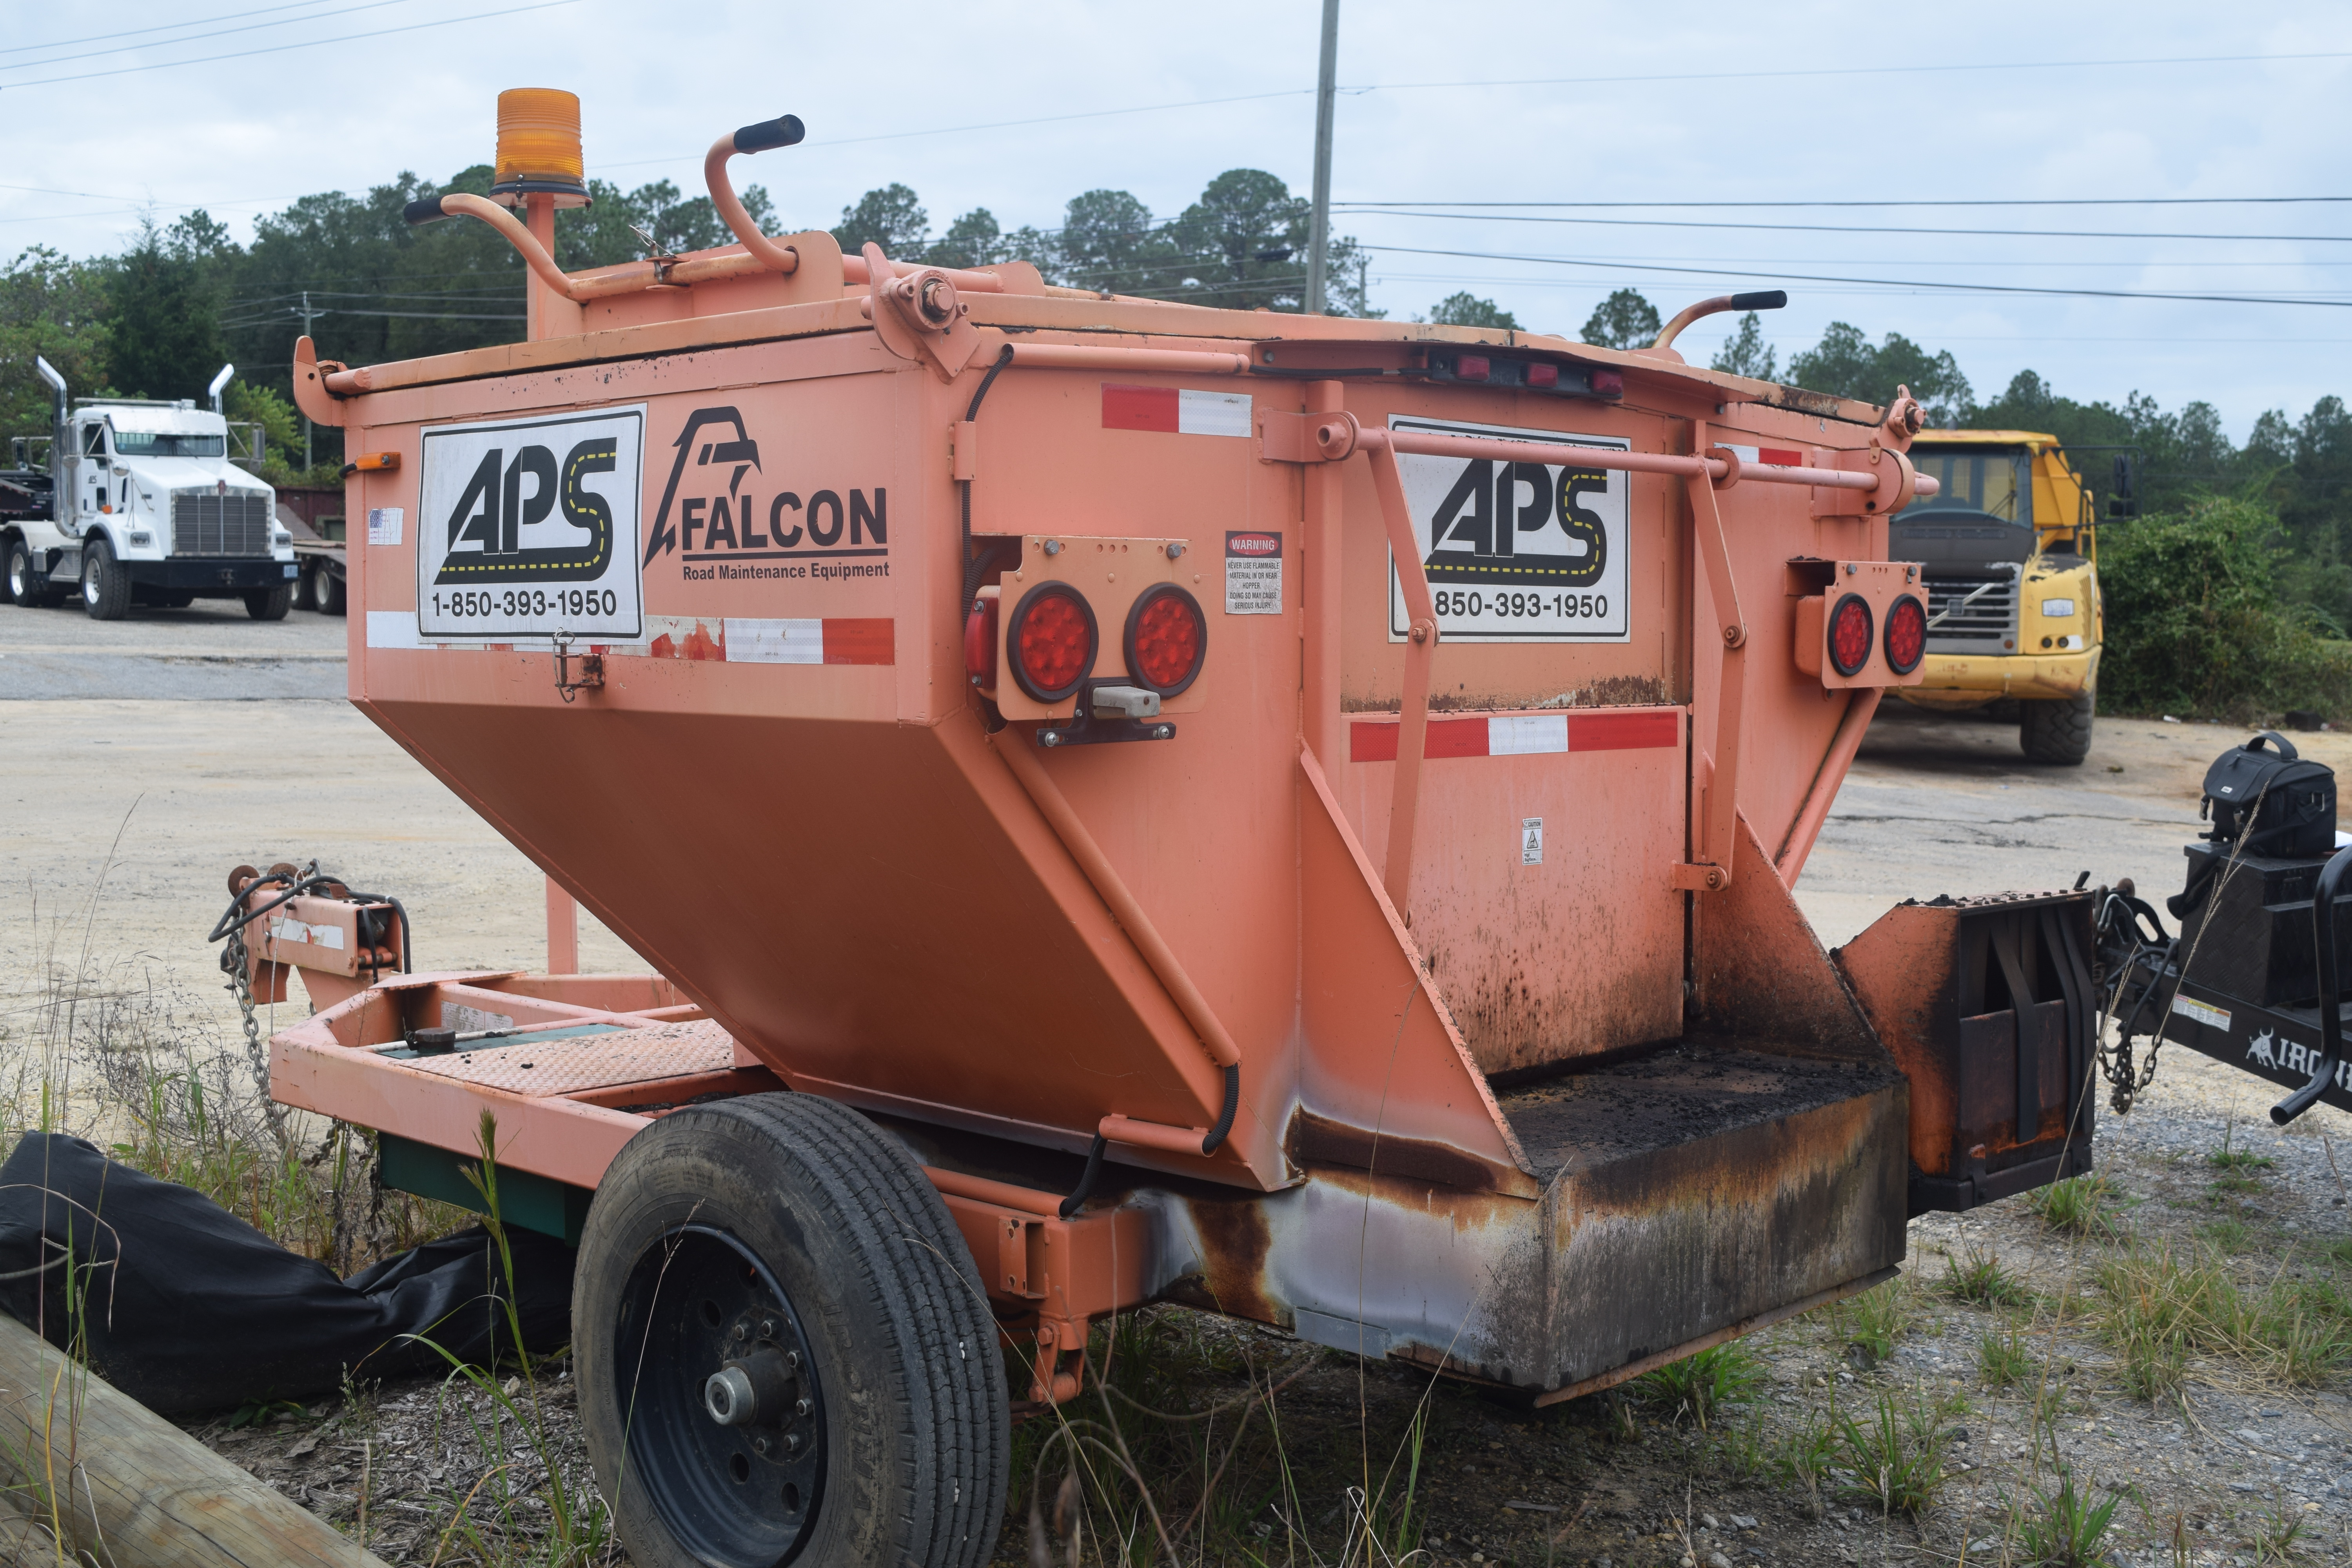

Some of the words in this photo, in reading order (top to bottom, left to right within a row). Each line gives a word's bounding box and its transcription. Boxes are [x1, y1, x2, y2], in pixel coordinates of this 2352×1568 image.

[434, 437, 617, 585] APS
[682, 487, 887, 550] FALCON
[1423, 458, 1608, 588] APS
[1232, 539, 1275, 550] WARNING
[683, 565, 715, 581] Road
[719, 563, 806, 580] Maintenance
[811, 562, 889, 581] Equipment
[432, 589, 617, 617] 1-850-393-1950
